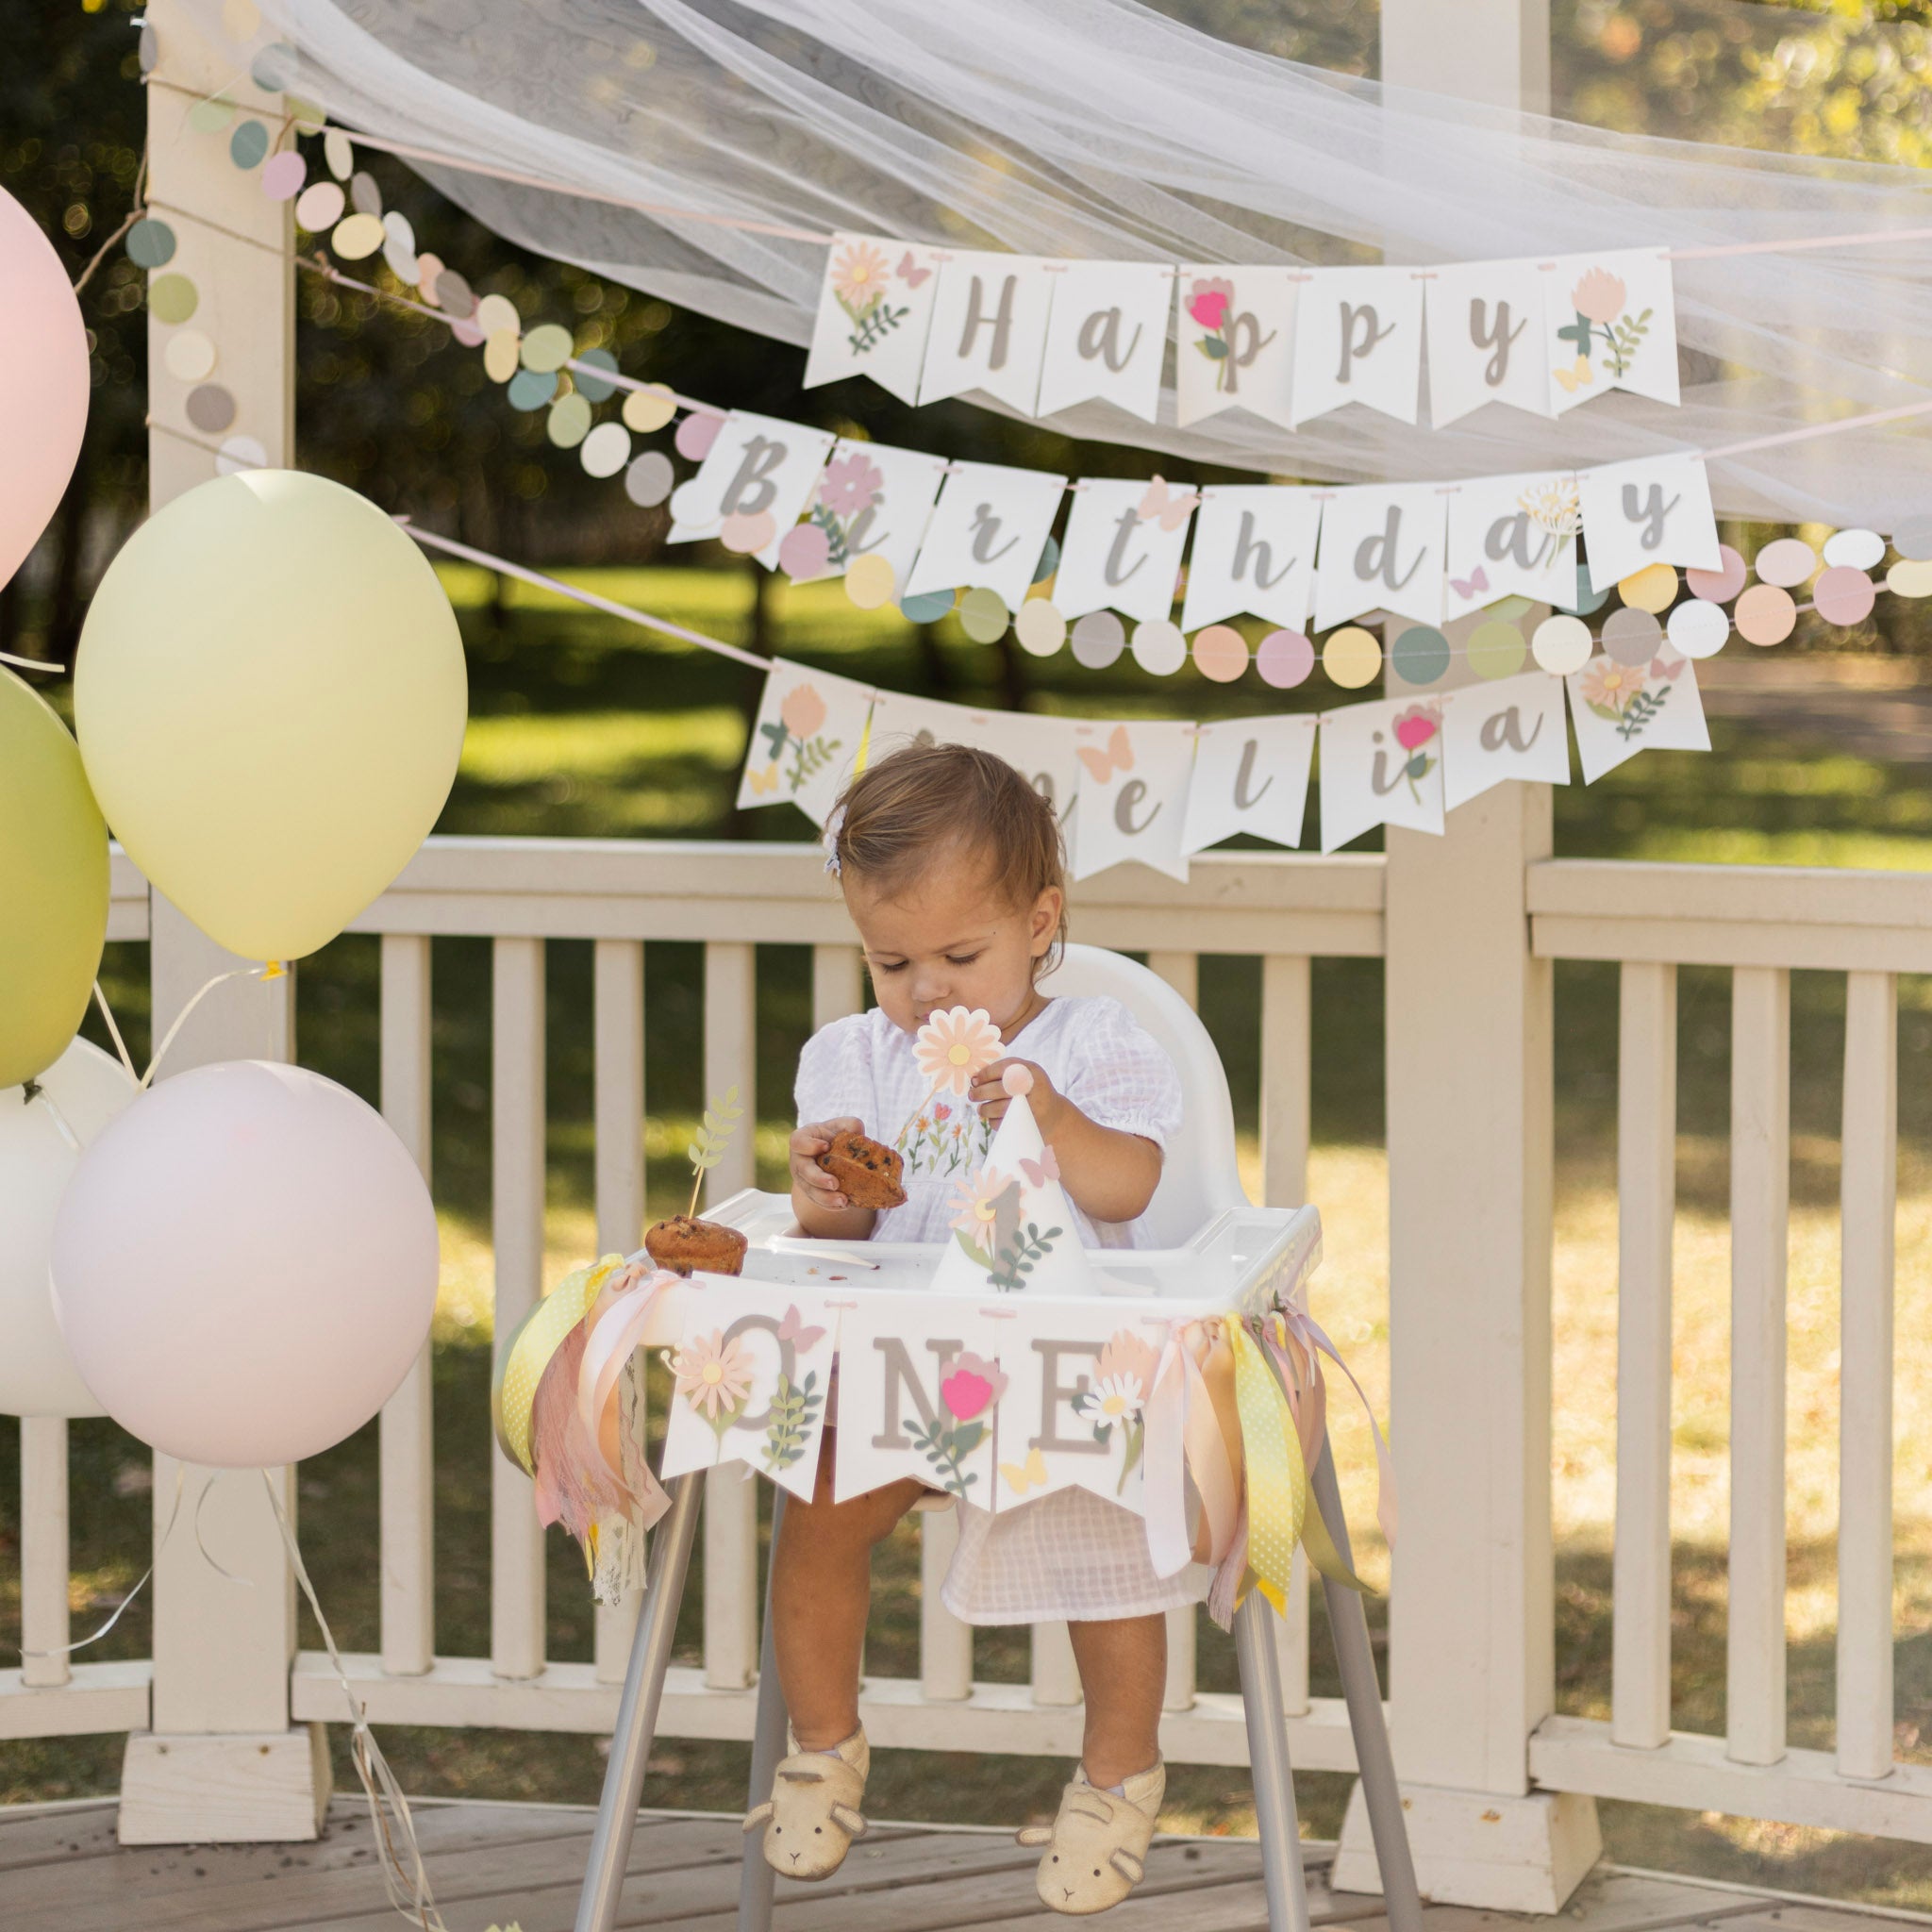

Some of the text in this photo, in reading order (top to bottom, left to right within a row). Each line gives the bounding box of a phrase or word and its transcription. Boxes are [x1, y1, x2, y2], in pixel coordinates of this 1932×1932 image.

[957, 274, 1527, 394] Happy
[719, 434, 1681, 591] Birthday
[913, 706, 1543, 836] elia
[985, 1180, 1026, 1289] 1
[717, 1313, 1112, 1455] ONE
